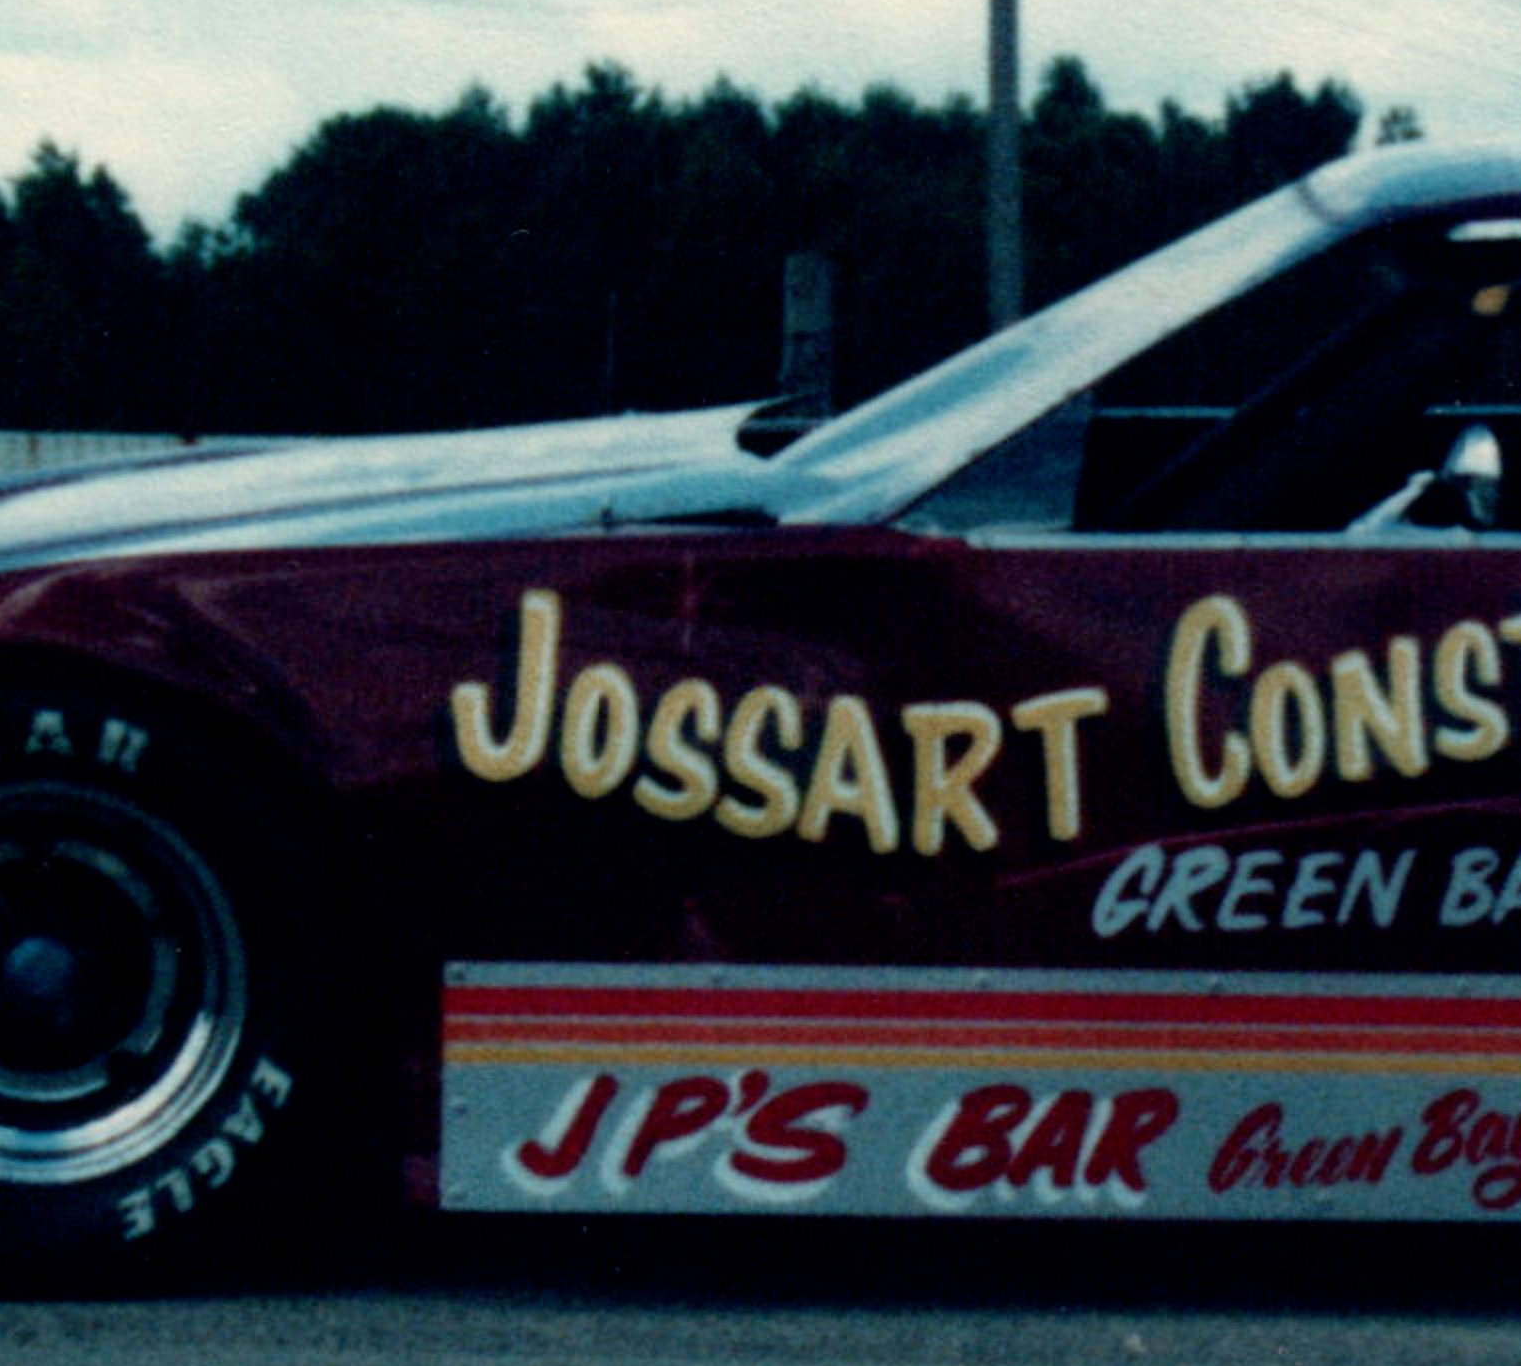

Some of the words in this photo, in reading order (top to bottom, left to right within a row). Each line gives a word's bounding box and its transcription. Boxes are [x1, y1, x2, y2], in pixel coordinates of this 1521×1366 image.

[1090, 842, 1417, 938] GREEN
[117, 1055, 294, 1242] EAGLE
[509, 1070, 870, 1196] JP'S
[915, 1082, 1181, 1204] BAR
[1207, 1104, 1401, 1195] Green
